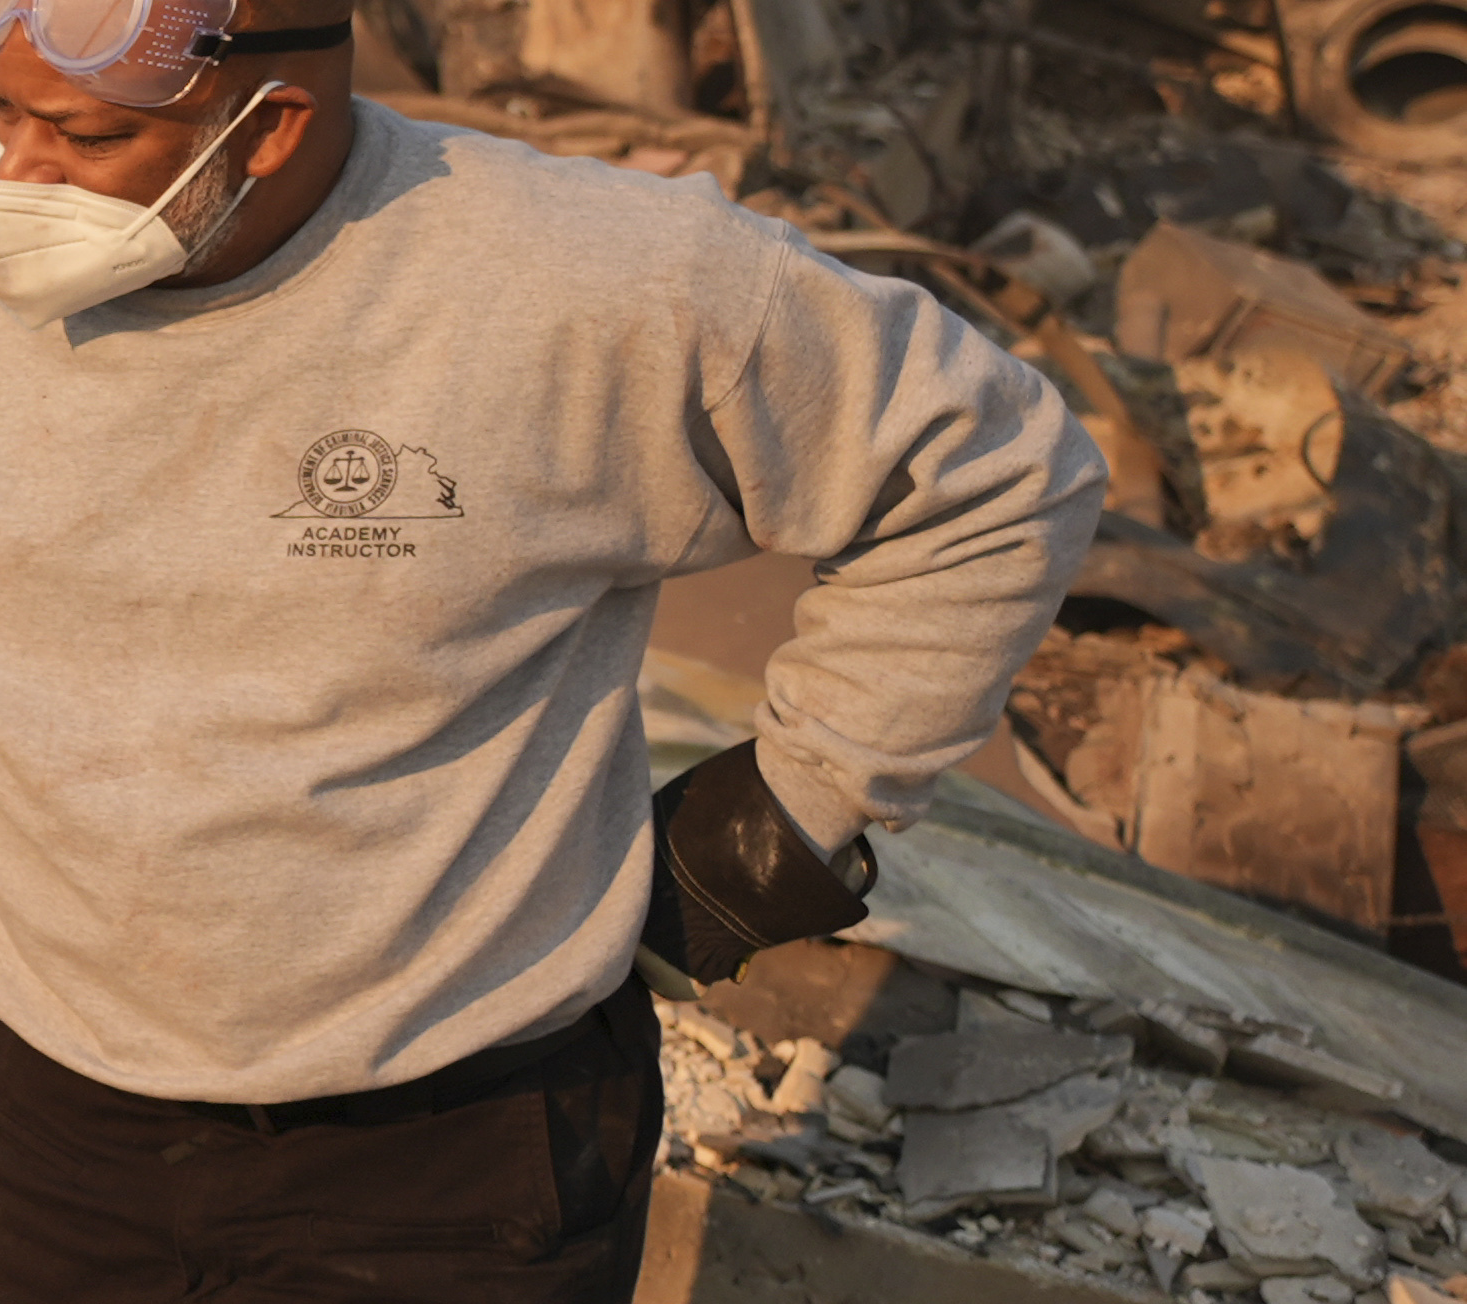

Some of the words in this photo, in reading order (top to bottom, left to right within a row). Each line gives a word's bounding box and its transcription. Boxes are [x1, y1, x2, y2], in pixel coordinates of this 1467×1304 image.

[368, 468, 394, 505] SERVICES
[302, 527, 401, 541] ACADEMY
[287, 543, 416, 557] INSTRUCTOR
